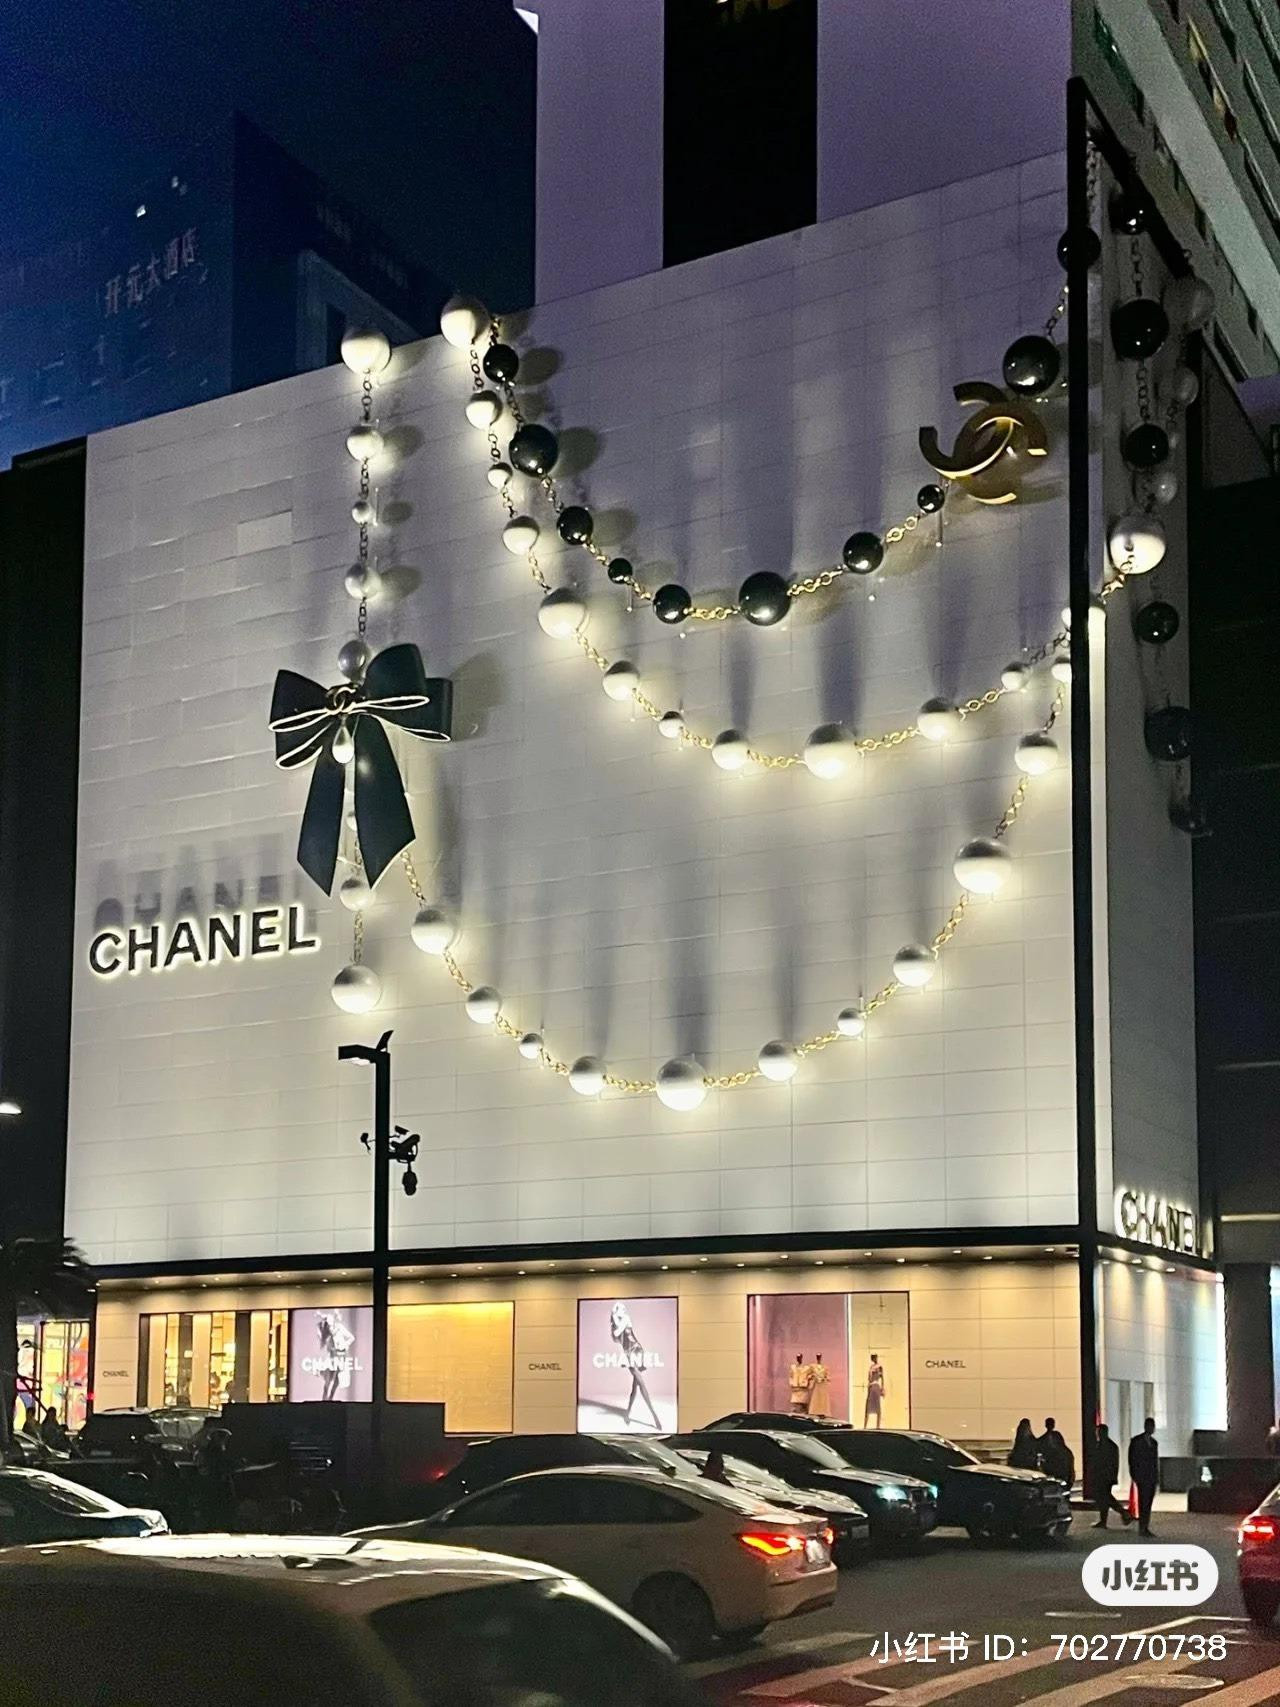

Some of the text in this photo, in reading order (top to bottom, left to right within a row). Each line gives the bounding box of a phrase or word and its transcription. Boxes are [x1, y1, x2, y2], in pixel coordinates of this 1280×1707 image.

[89, 906, 317, 975] CHANEL
[302, 1357, 363, 1371] CHANEL
[592, 1352, 664, 1368] CHANEL
[925, 1360, 966, 1368] CHANEL
[528, 1362, 562, 1371] CHANEL
[102, 1370, 129, 1378] CHANEL
